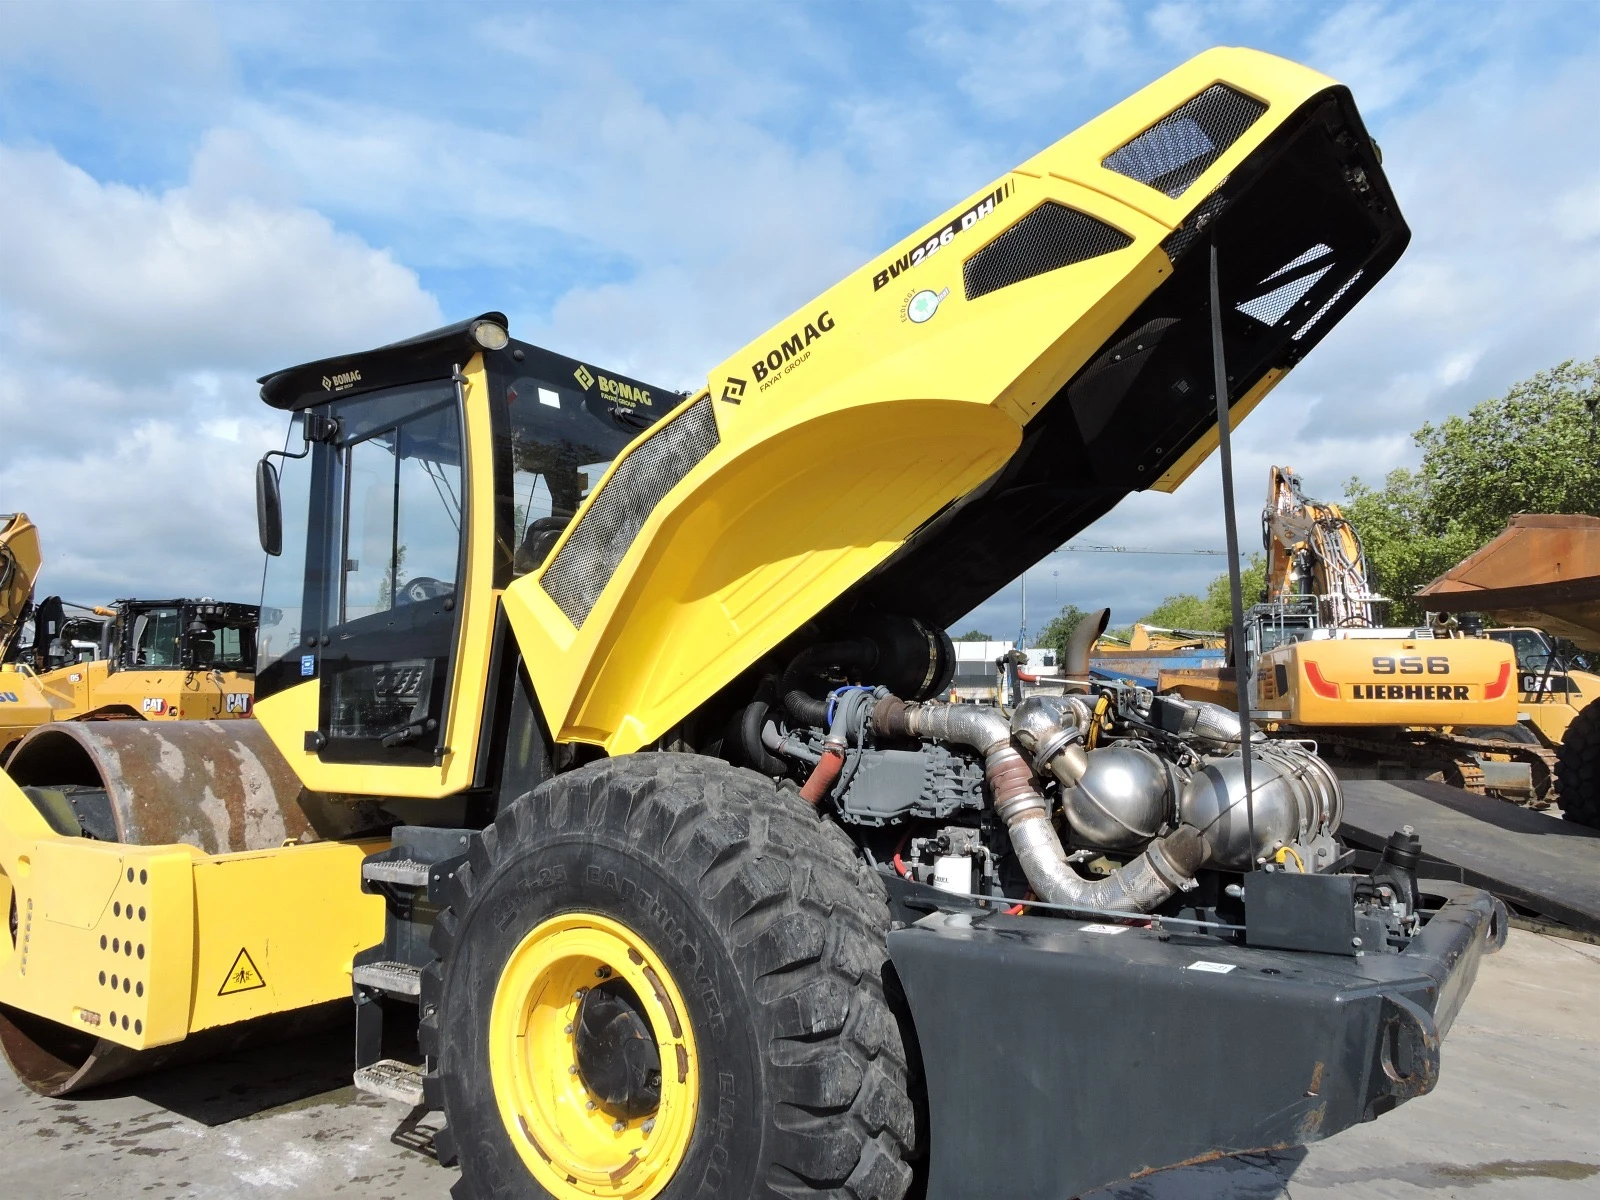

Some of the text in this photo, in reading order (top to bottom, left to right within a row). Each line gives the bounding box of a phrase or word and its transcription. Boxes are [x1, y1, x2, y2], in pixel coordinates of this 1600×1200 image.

[961, 197, 995, 232] DH
[900, 288, 916, 323] ECOLOGY
[751, 310, 836, 383] BOMAG
[331, 369, 361, 386] BOMAG
[759, 351, 811, 392] FAYAT GROUP
[597, 375, 653, 406] BOMAG
[1372, 656, 1450, 674] 956
[226, 693, 249, 713] CAT
[1353, 685, 1469, 700] LIEBHERR
[143, 698, 163, 713] CAT
